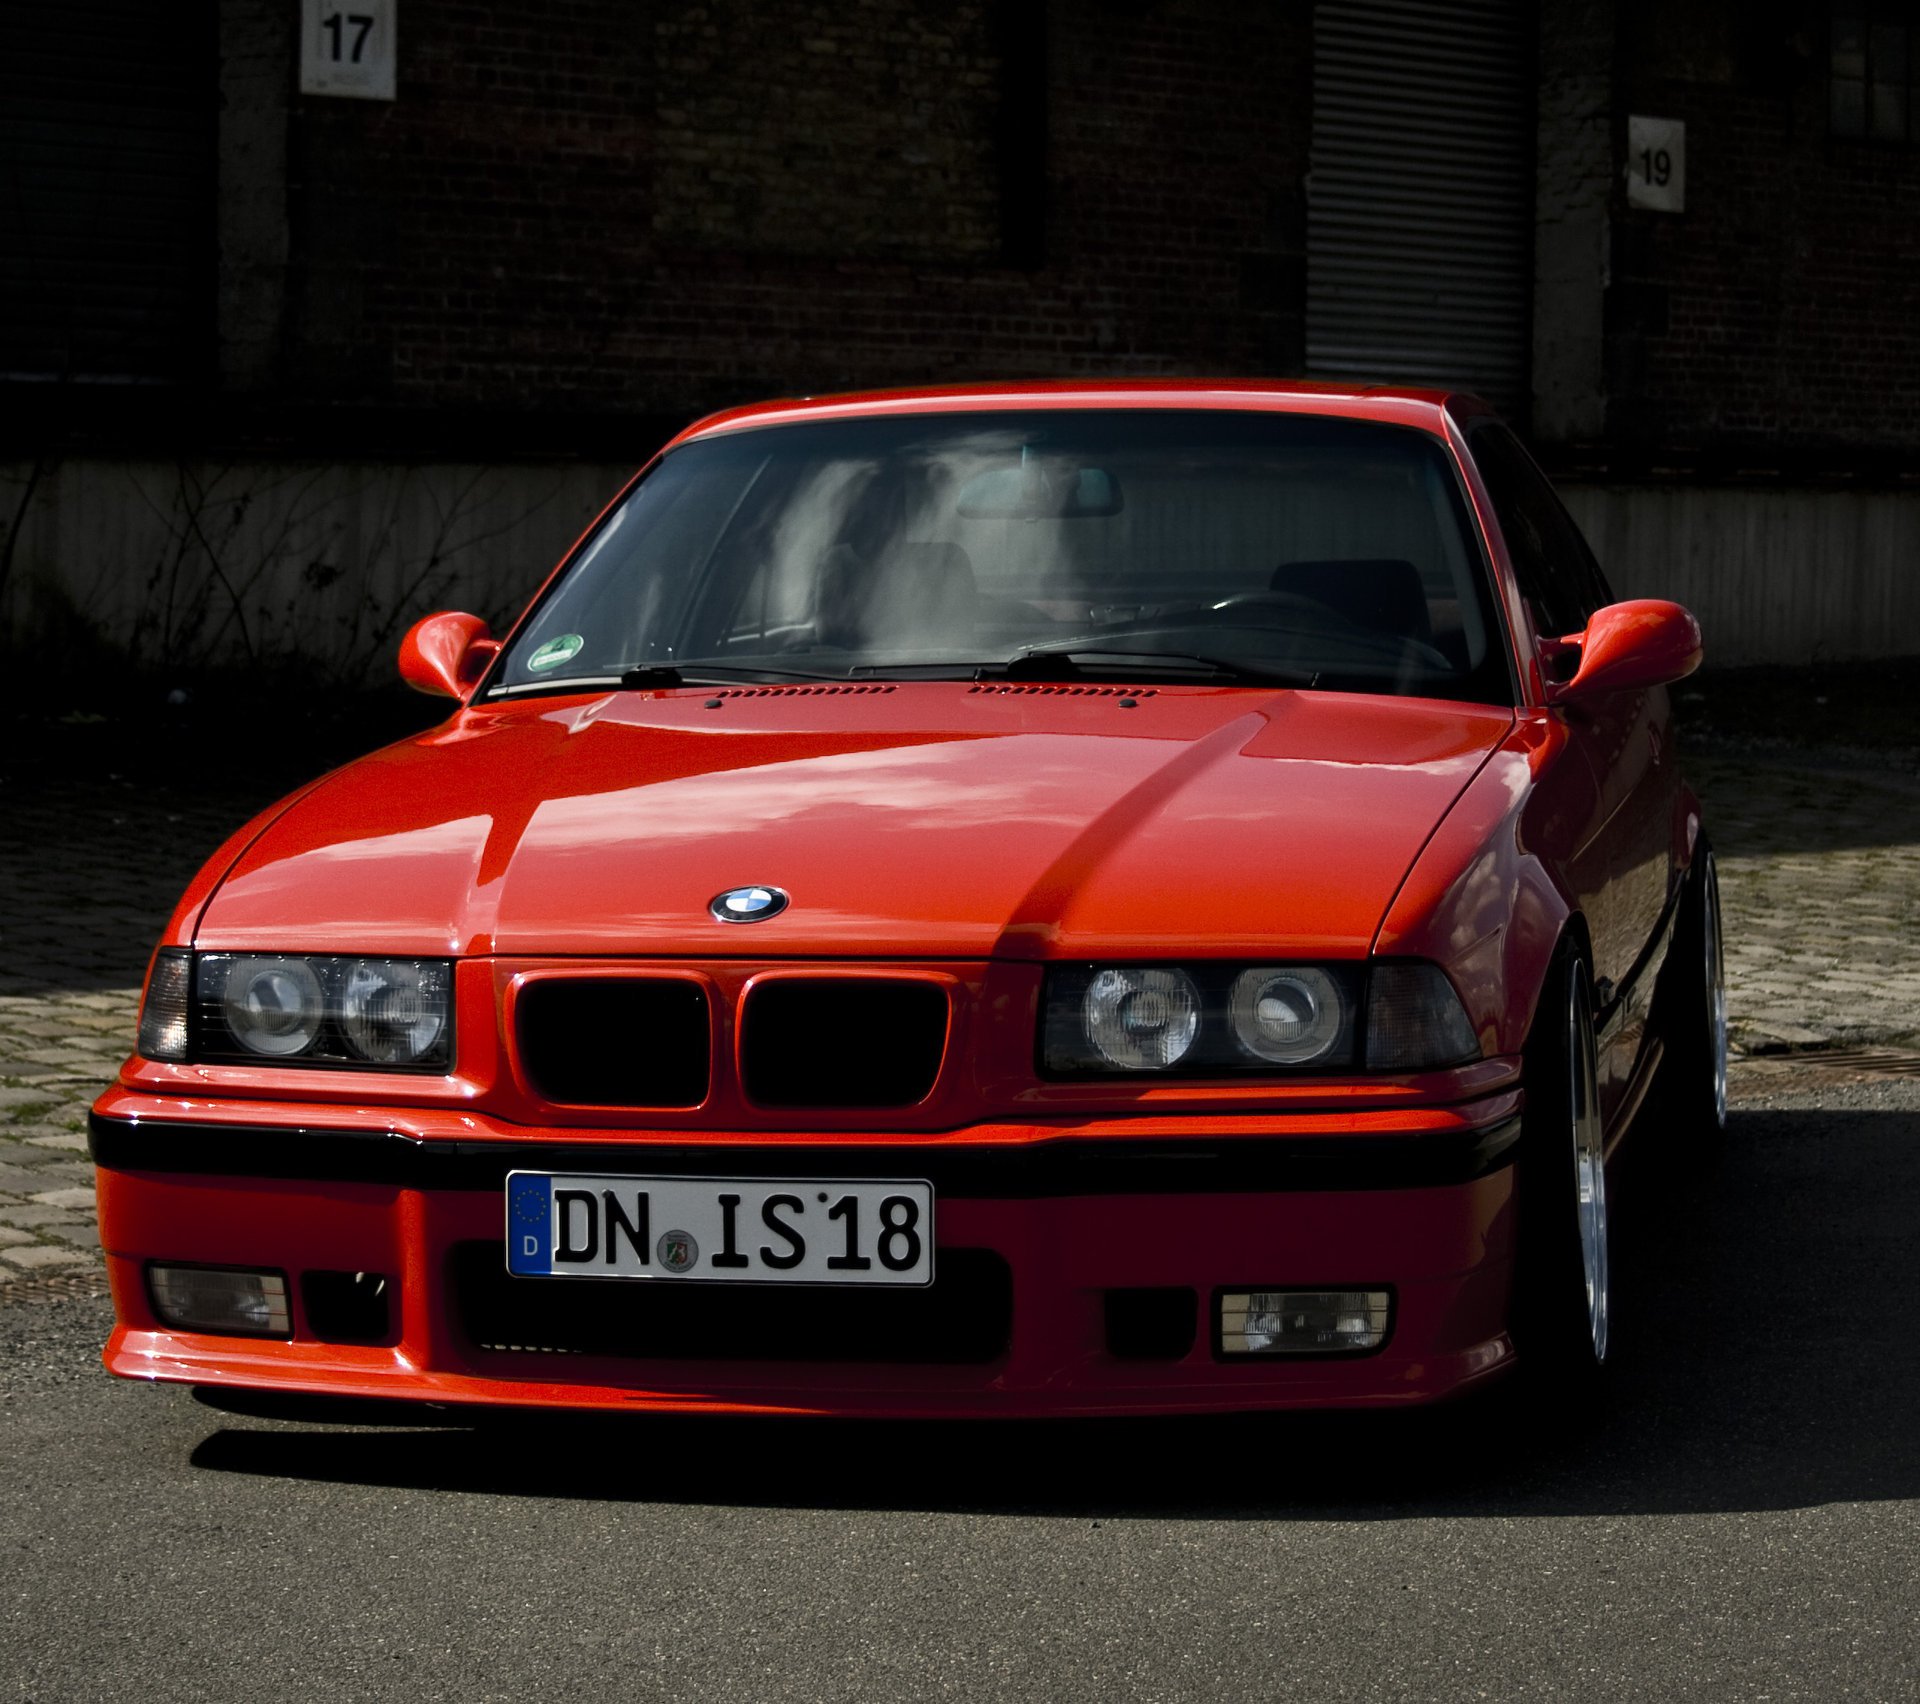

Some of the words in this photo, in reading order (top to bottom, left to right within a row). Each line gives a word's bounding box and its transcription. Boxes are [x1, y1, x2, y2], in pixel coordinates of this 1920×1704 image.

[322, 12, 374, 63] 17
[1640, 148, 1671, 187] 19
[523, 1236, 538, 1256] D
[554, 1189, 650, 1265] DN
